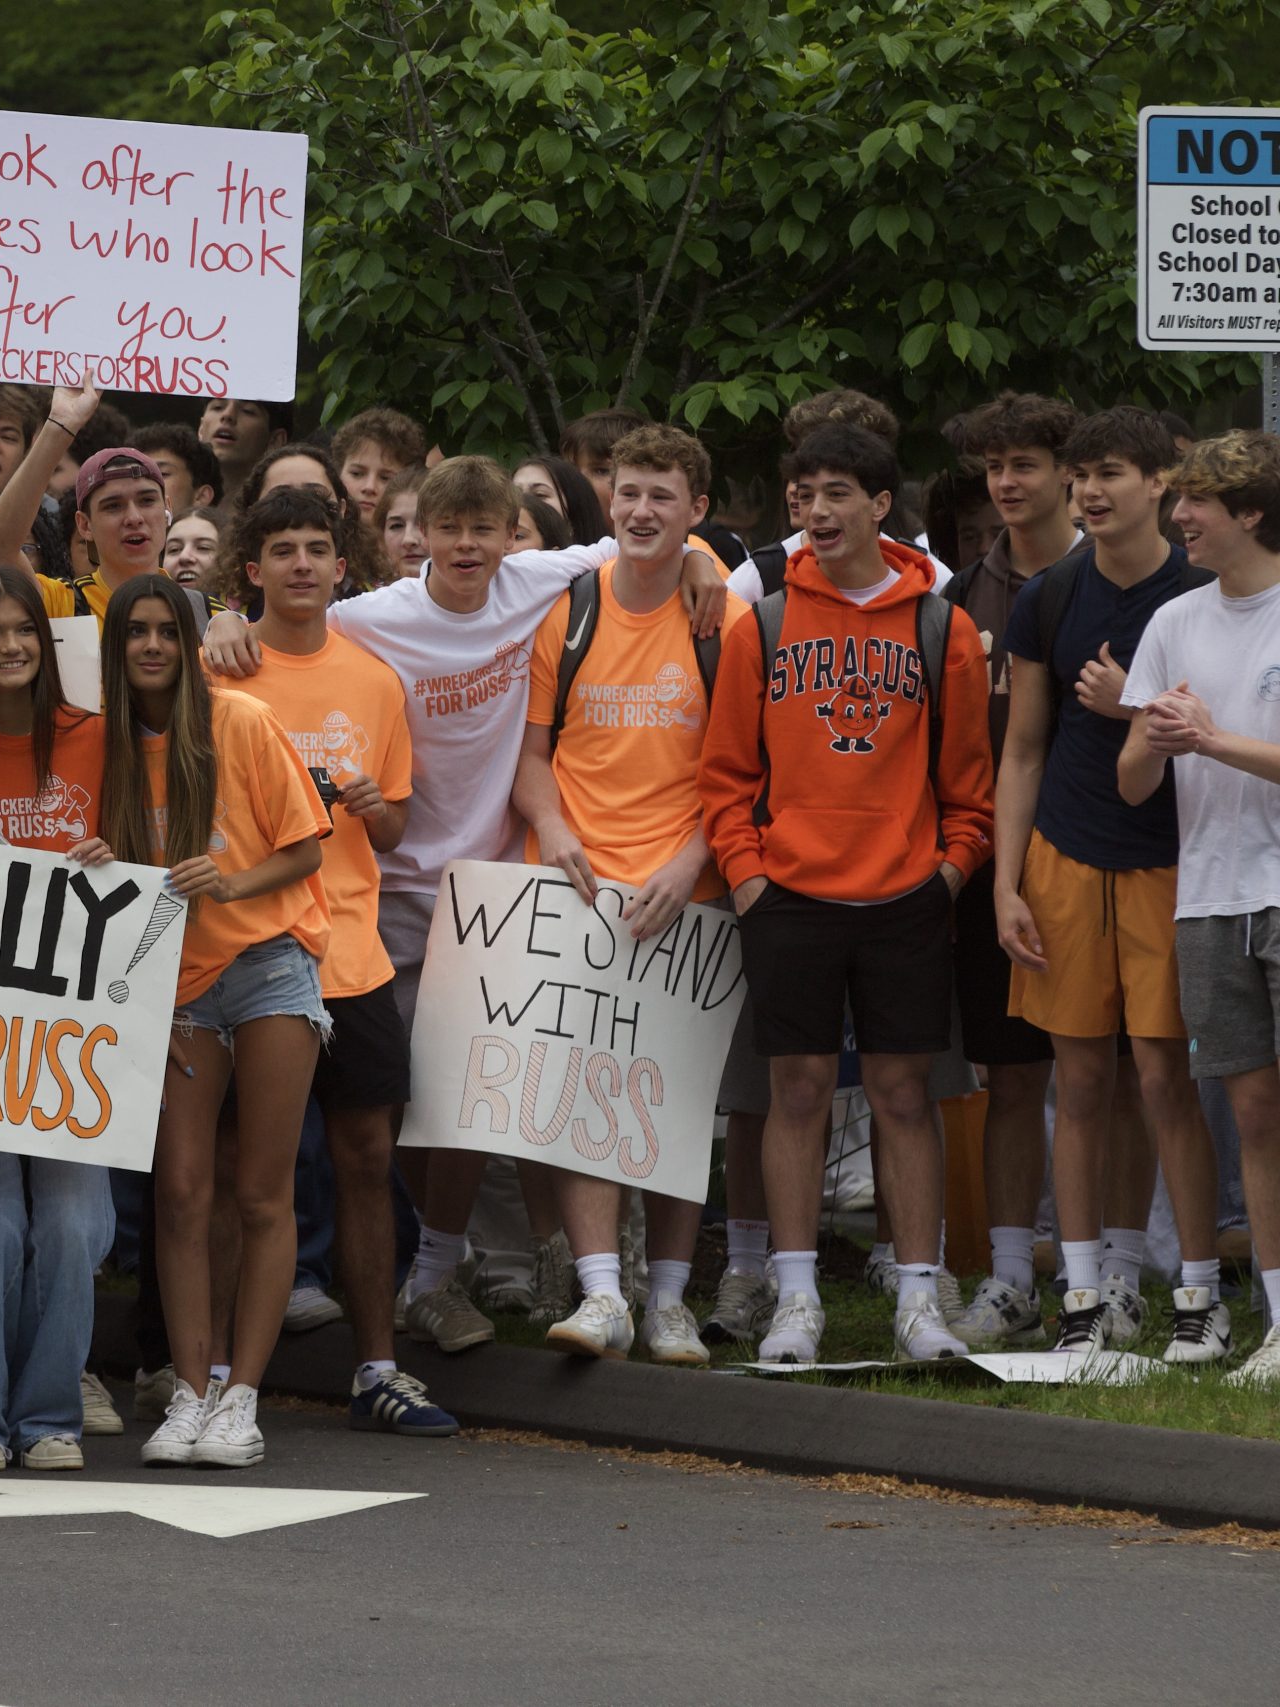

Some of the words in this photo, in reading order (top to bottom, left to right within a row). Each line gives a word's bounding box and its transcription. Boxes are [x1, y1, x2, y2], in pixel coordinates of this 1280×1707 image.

[82, 144, 195, 206] after
[217, 161, 293, 225] the
[1191, 195, 1271, 217] School
[1172, 222, 1251, 245] Closed
[1259, 226, 1280, 245] to
[70, 219, 170, 263] who
[189, 217, 295, 278] look
[1158, 251, 1238, 273] School
[1172, 282, 1257, 302] 7:30am
[1263, 286, 1280, 303] a
[117, 301, 227, 363] you.
[1157, 315, 1175, 329] All
[1177, 315, 1225, 329] Visitors
[1227, 316, 1263, 330] MUST
[413, 665, 493, 697] #WRECKERS
[577, 683, 657, 702] #WRECKERS
[425, 692, 463, 718] FOR
[584, 702, 620, 727] FOR
[623, 703, 671, 728] RUSS
[449, 872, 577, 958] WE
[479, 976, 641, 1056] WITH
[457, 1035, 664, 1179] RUSS
